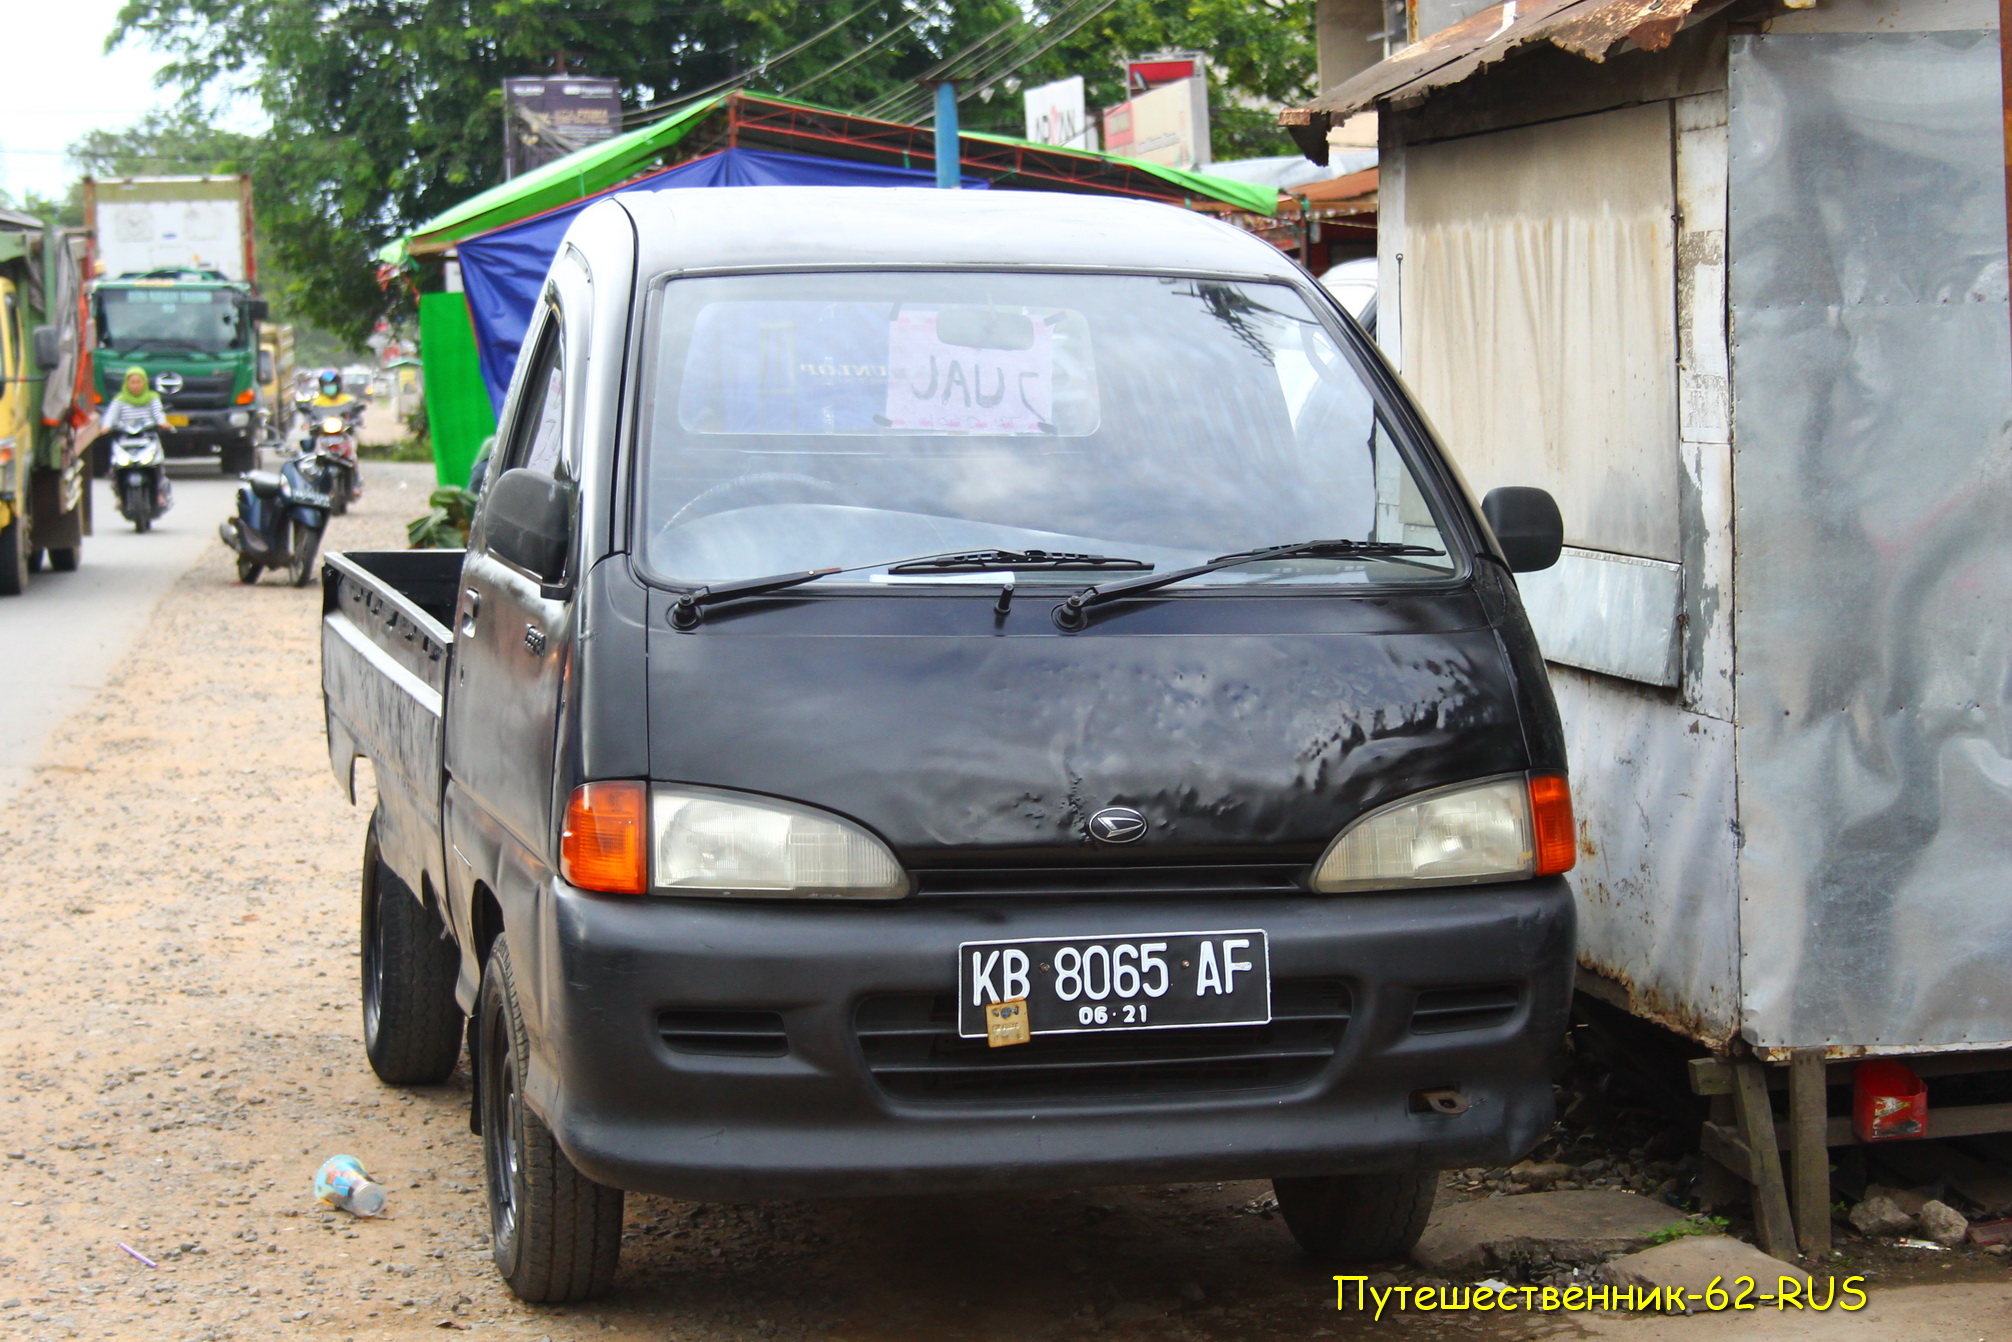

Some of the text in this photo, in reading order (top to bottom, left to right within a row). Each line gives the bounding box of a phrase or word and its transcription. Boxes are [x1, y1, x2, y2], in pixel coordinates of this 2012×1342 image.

[973, 939, 1252, 1006] KB 8065 AF
